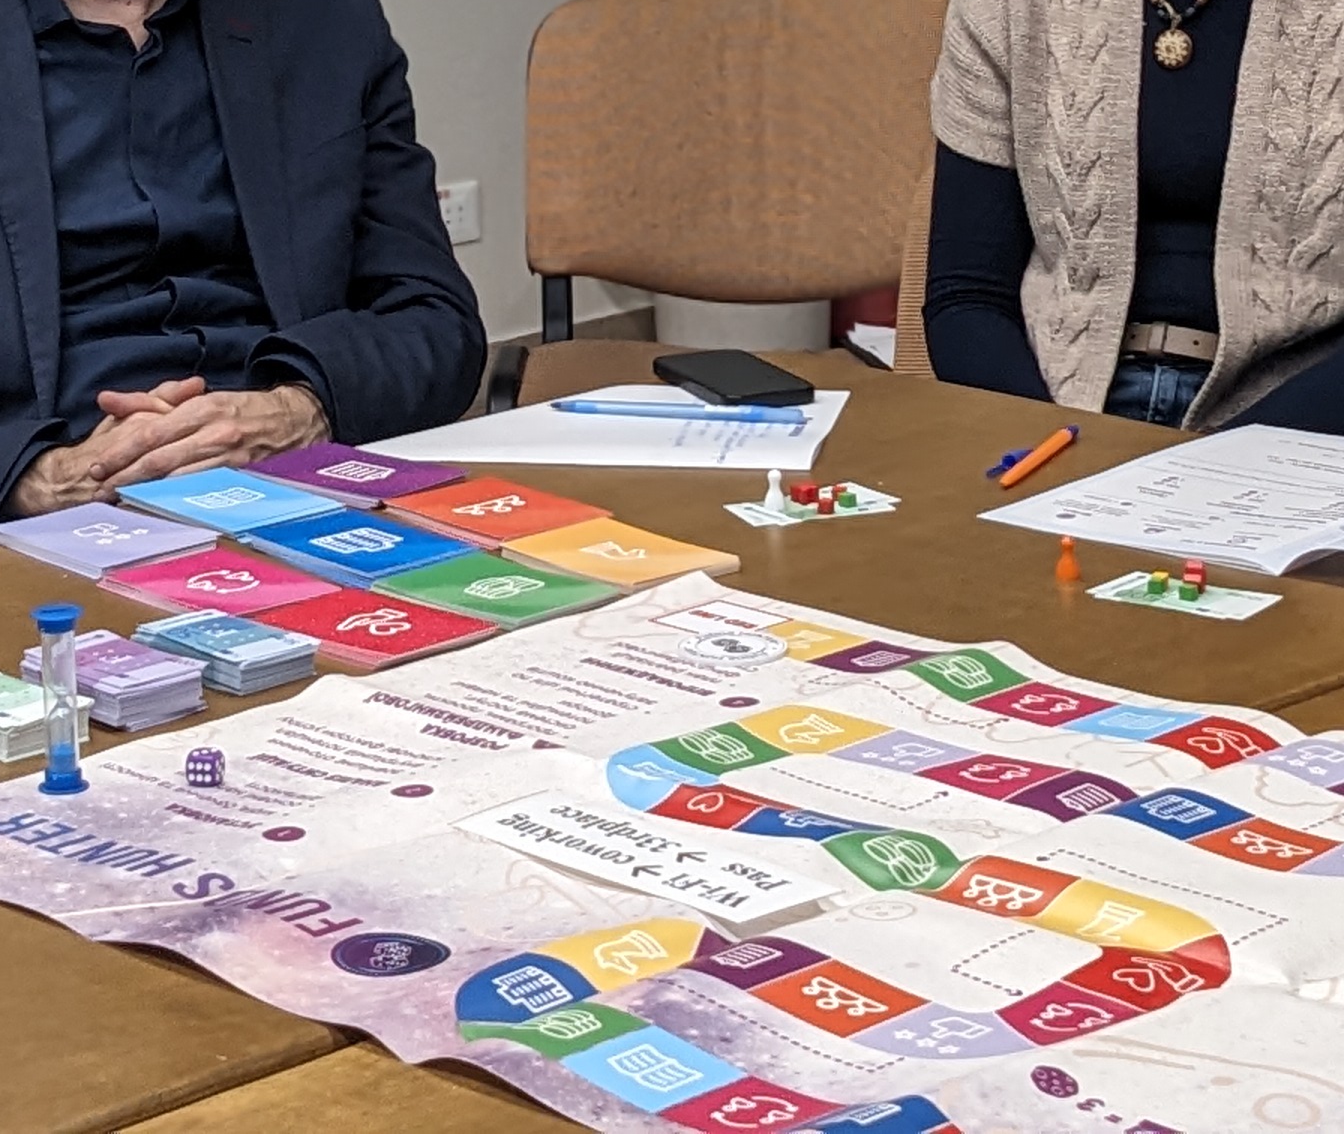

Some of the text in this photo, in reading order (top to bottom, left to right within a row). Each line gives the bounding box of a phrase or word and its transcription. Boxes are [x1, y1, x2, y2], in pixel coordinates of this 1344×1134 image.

[363, 691, 525, 739] ФАНДРЕЙЗИНГОВОЇ
[420, 723, 509, 750] РОЗРОБКА
[246, 753, 391, 787] АНАЛІЗ СИТУАЦІЇ
[164, 803, 263, 829] УСТАНОВКА
[495, 812, 752, 909] Wi-Fi coworking
[547, 805, 793, 892] Pass 33rdplace
[172, 872, 364, 939] FUNDS
